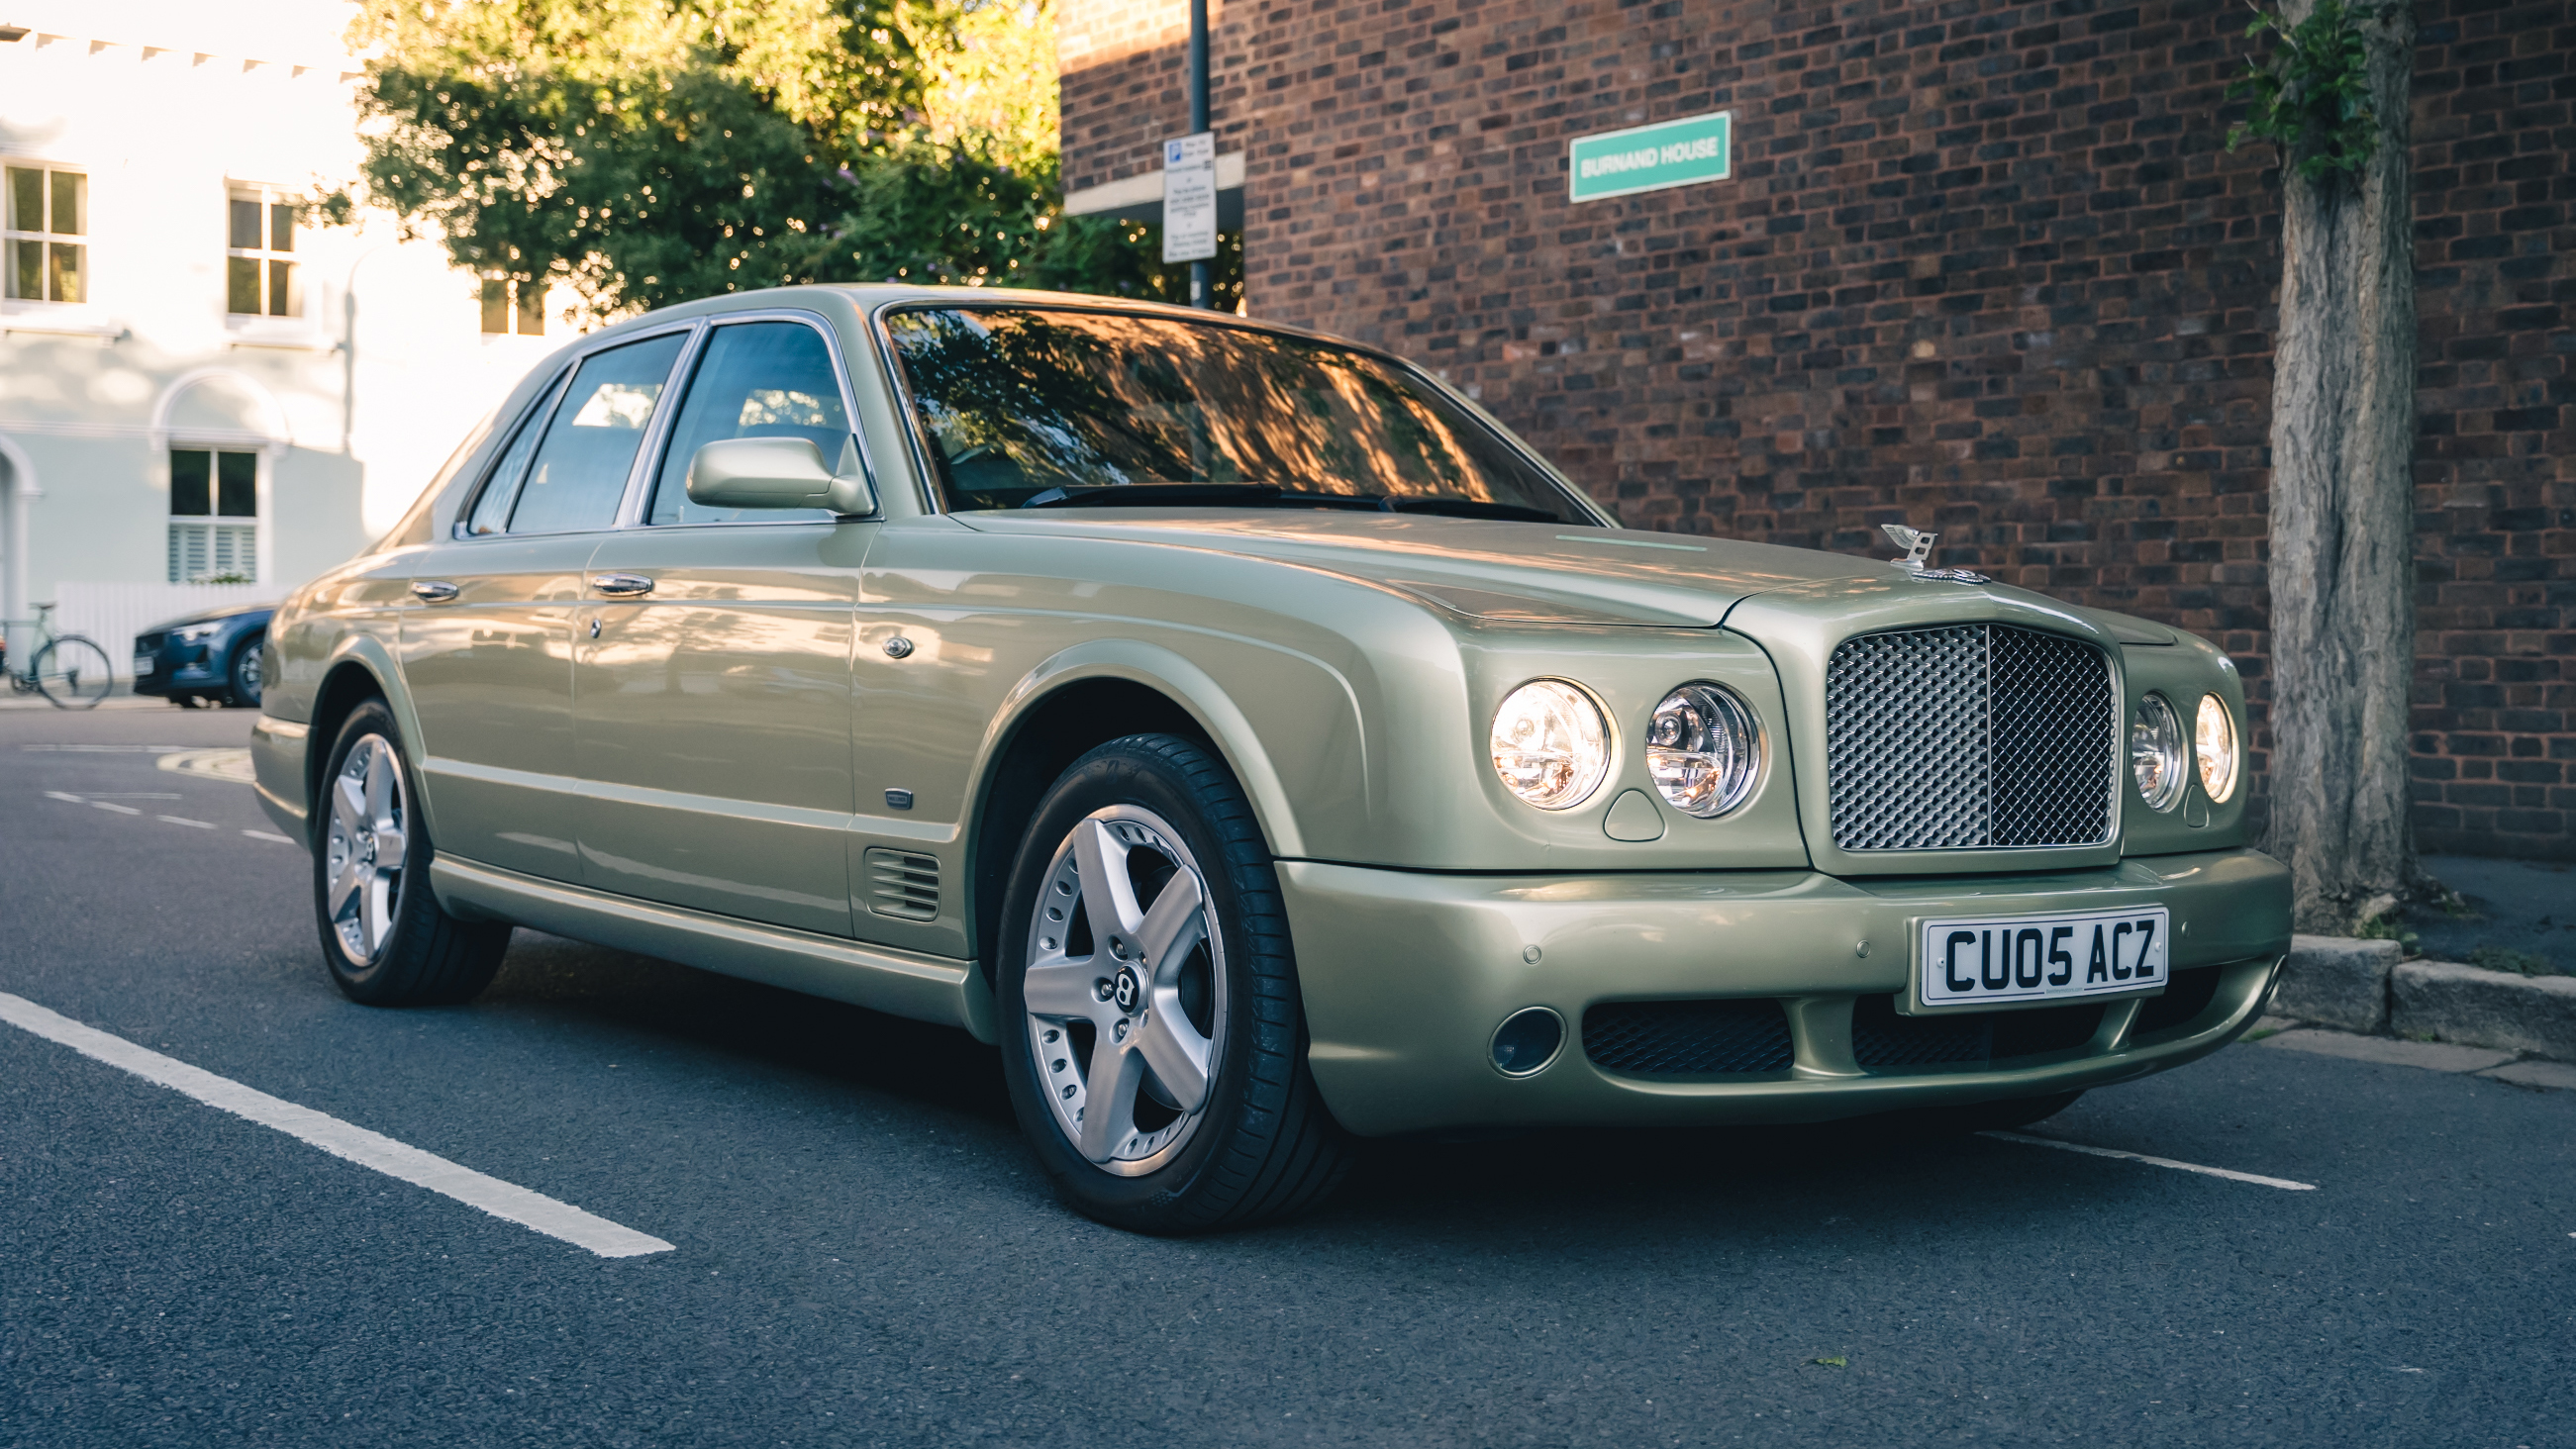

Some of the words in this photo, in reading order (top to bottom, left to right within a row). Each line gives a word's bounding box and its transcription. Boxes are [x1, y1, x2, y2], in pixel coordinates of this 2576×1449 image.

[1581, 147, 1658, 178] BURNAND
[1661, 137, 1718, 164] HOUSE
[1945, 926, 2074, 992] CU05
[2086, 918, 2155, 984] ACZ
